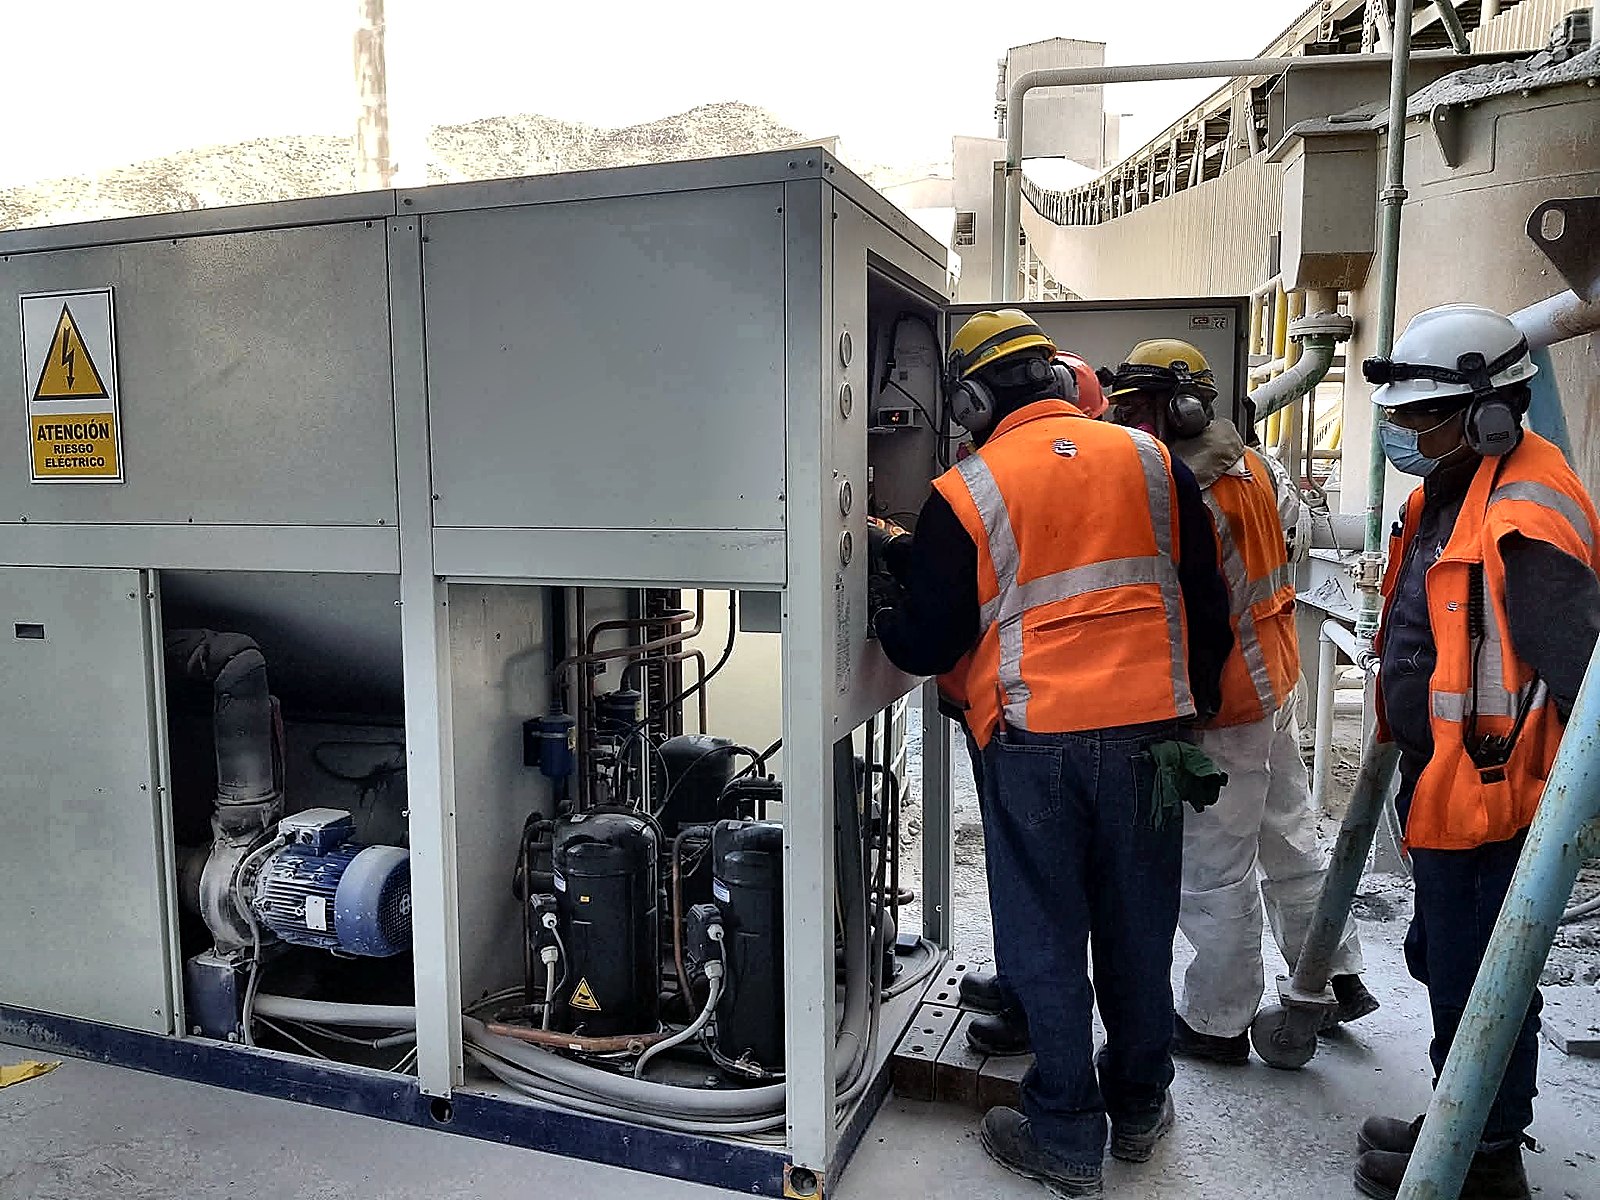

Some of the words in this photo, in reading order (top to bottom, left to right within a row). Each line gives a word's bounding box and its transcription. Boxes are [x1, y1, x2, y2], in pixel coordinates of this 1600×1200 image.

[37, 419, 109, 441] ATENCIÓN
[53, 442, 94, 455] RIESGO
[45, 455, 105, 468] ELÉCTRICO
